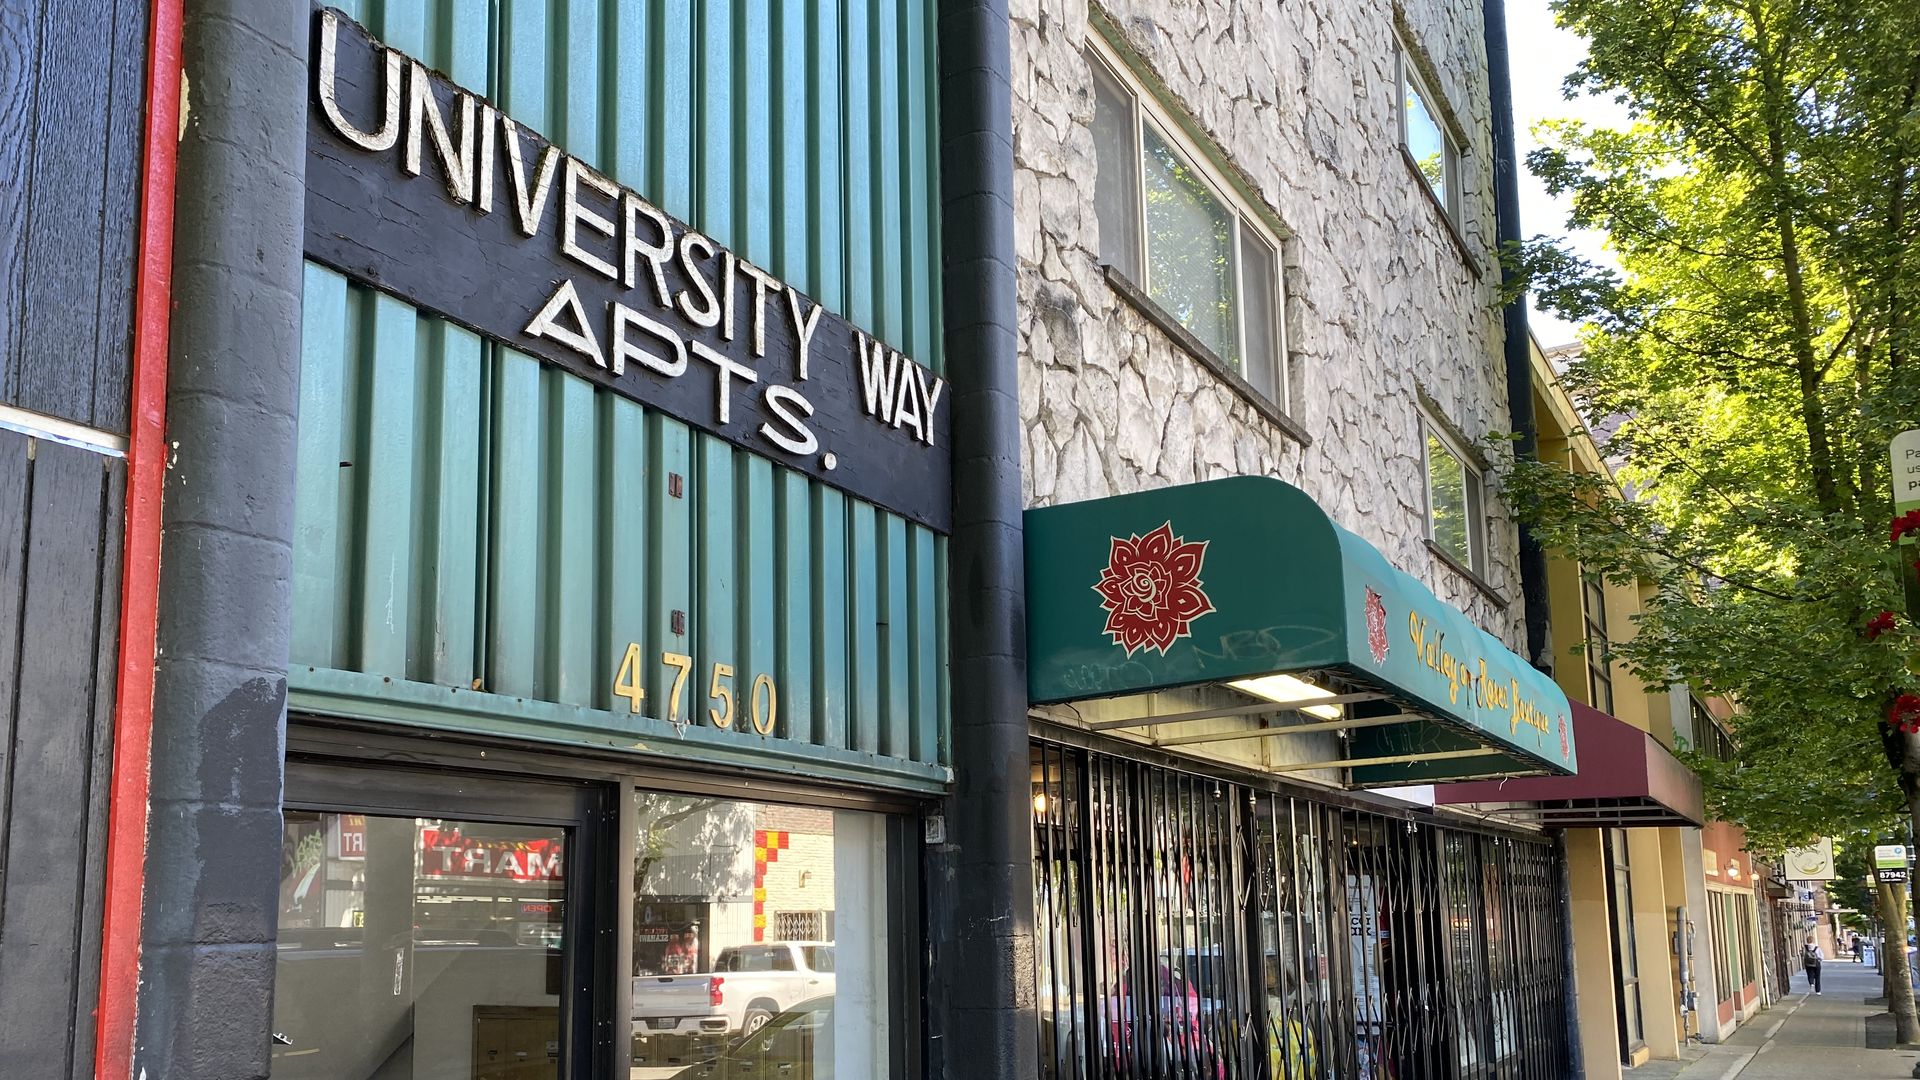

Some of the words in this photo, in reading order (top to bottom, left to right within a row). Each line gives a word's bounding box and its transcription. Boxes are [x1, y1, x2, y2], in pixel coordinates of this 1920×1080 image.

[318, 9, 823, 382] UNIVERSITY
[855, 330, 943, 447] WAY
[523, 278, 838, 471] APTS.
[614, 641, 777, 736] 4750
[1408, 609, 1459, 705] Valley
[1475, 657, 1508, 711] Roses
[1509, 678, 1550, 749] Boutique
[1880, 871, 1906, 879] 87942
